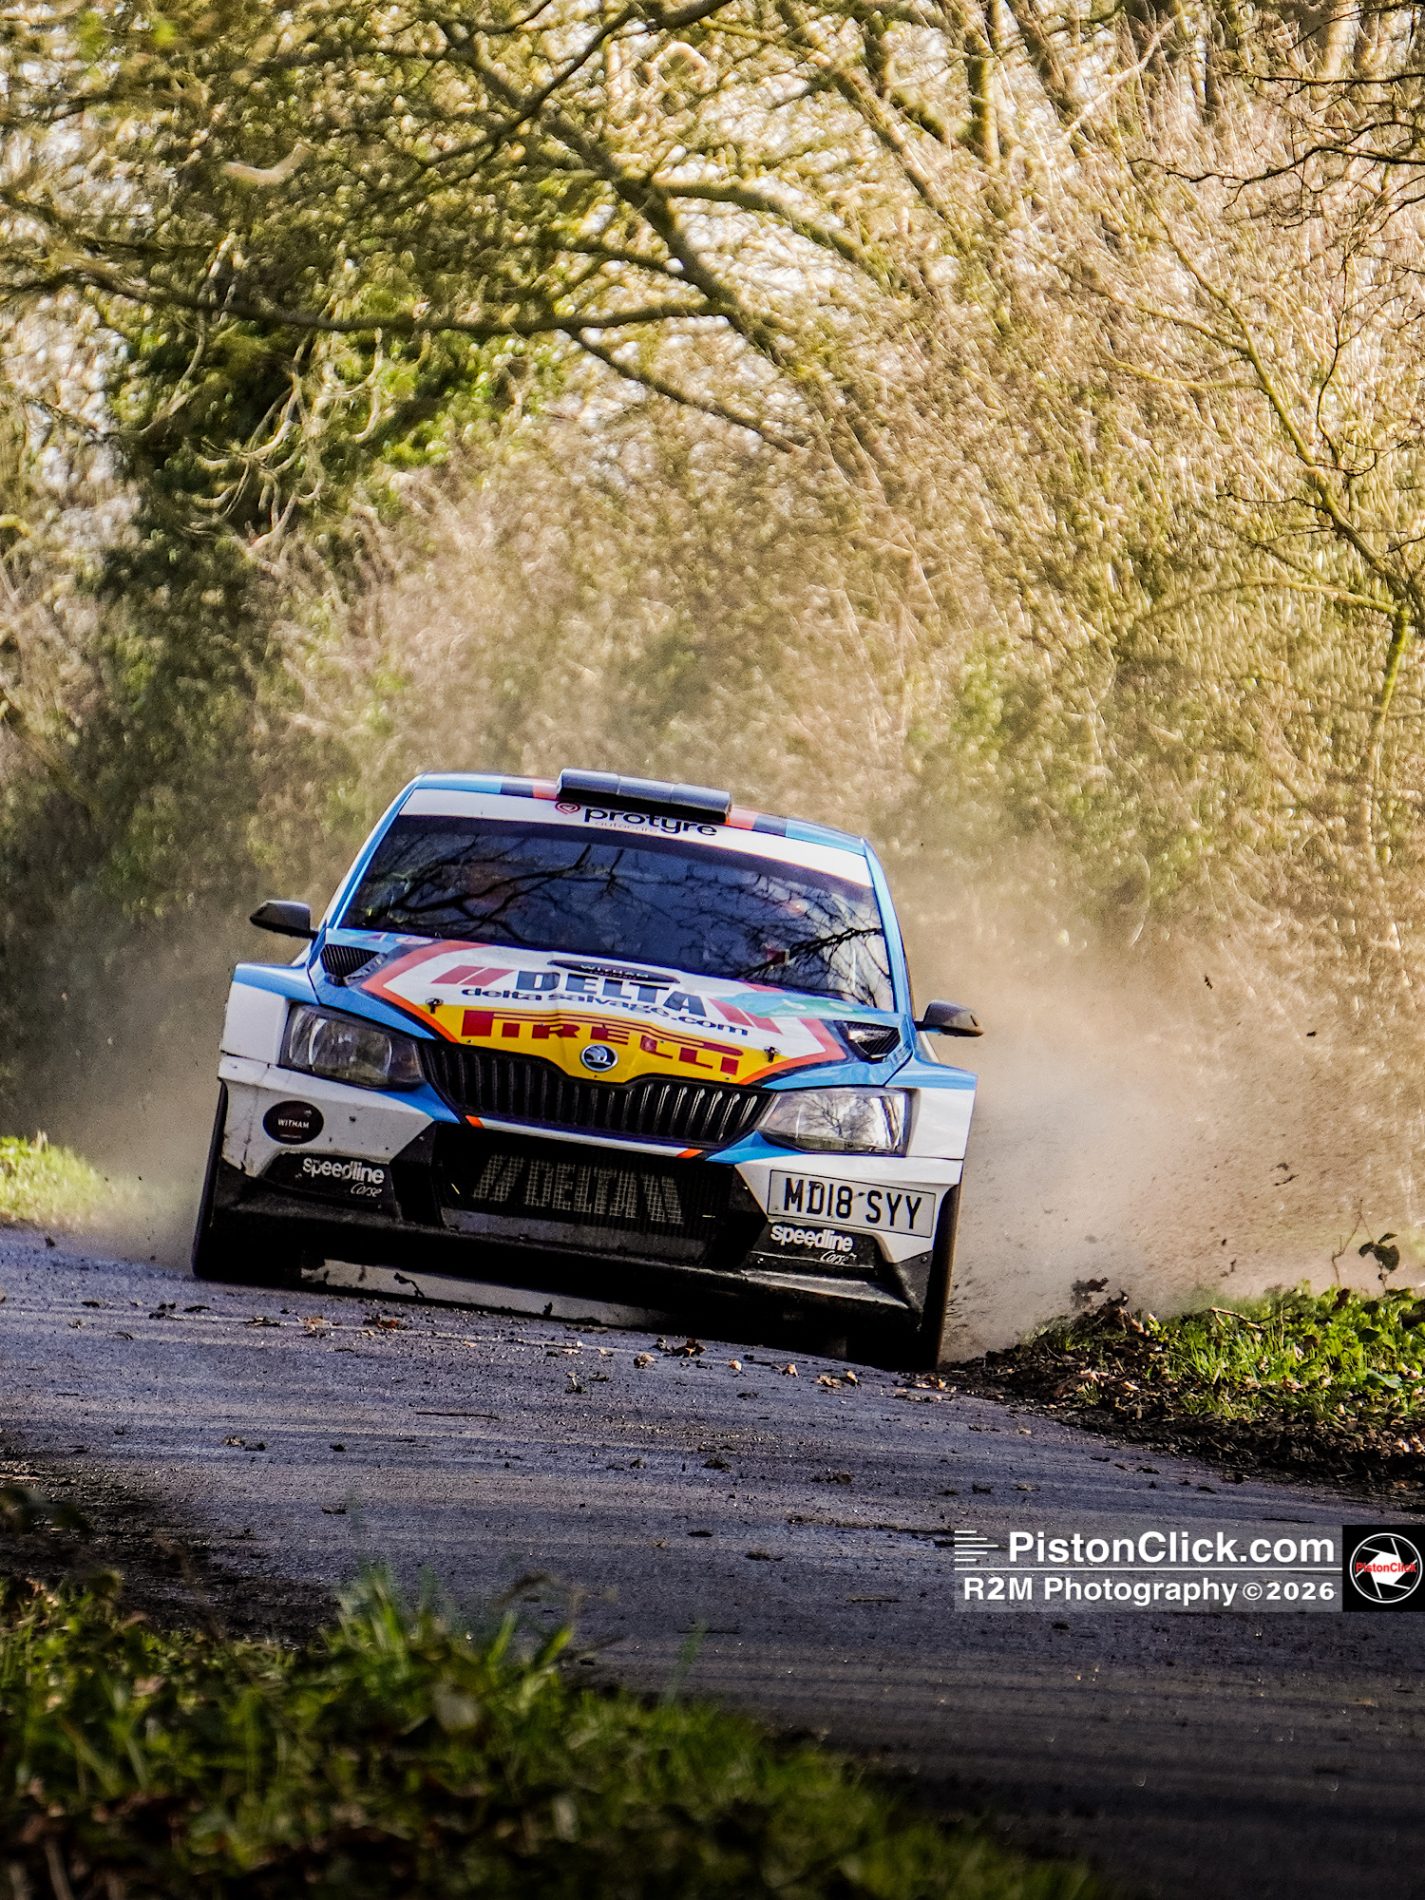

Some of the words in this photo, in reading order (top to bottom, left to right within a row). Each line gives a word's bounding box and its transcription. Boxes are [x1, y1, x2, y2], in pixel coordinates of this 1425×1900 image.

[584, 807, 718, 836] protyre
[515, 970, 706, 1017] DELTA
[461, 1009, 742, 1075] PIRELLI
[277, 1118, 310, 1129] WITHAM
[302, 1157, 385, 1184] speedline
[350, 1182, 382, 1198] Corse
[865, 1190, 923, 1230] SYY
[770, 1224, 853, 1252] speedline
